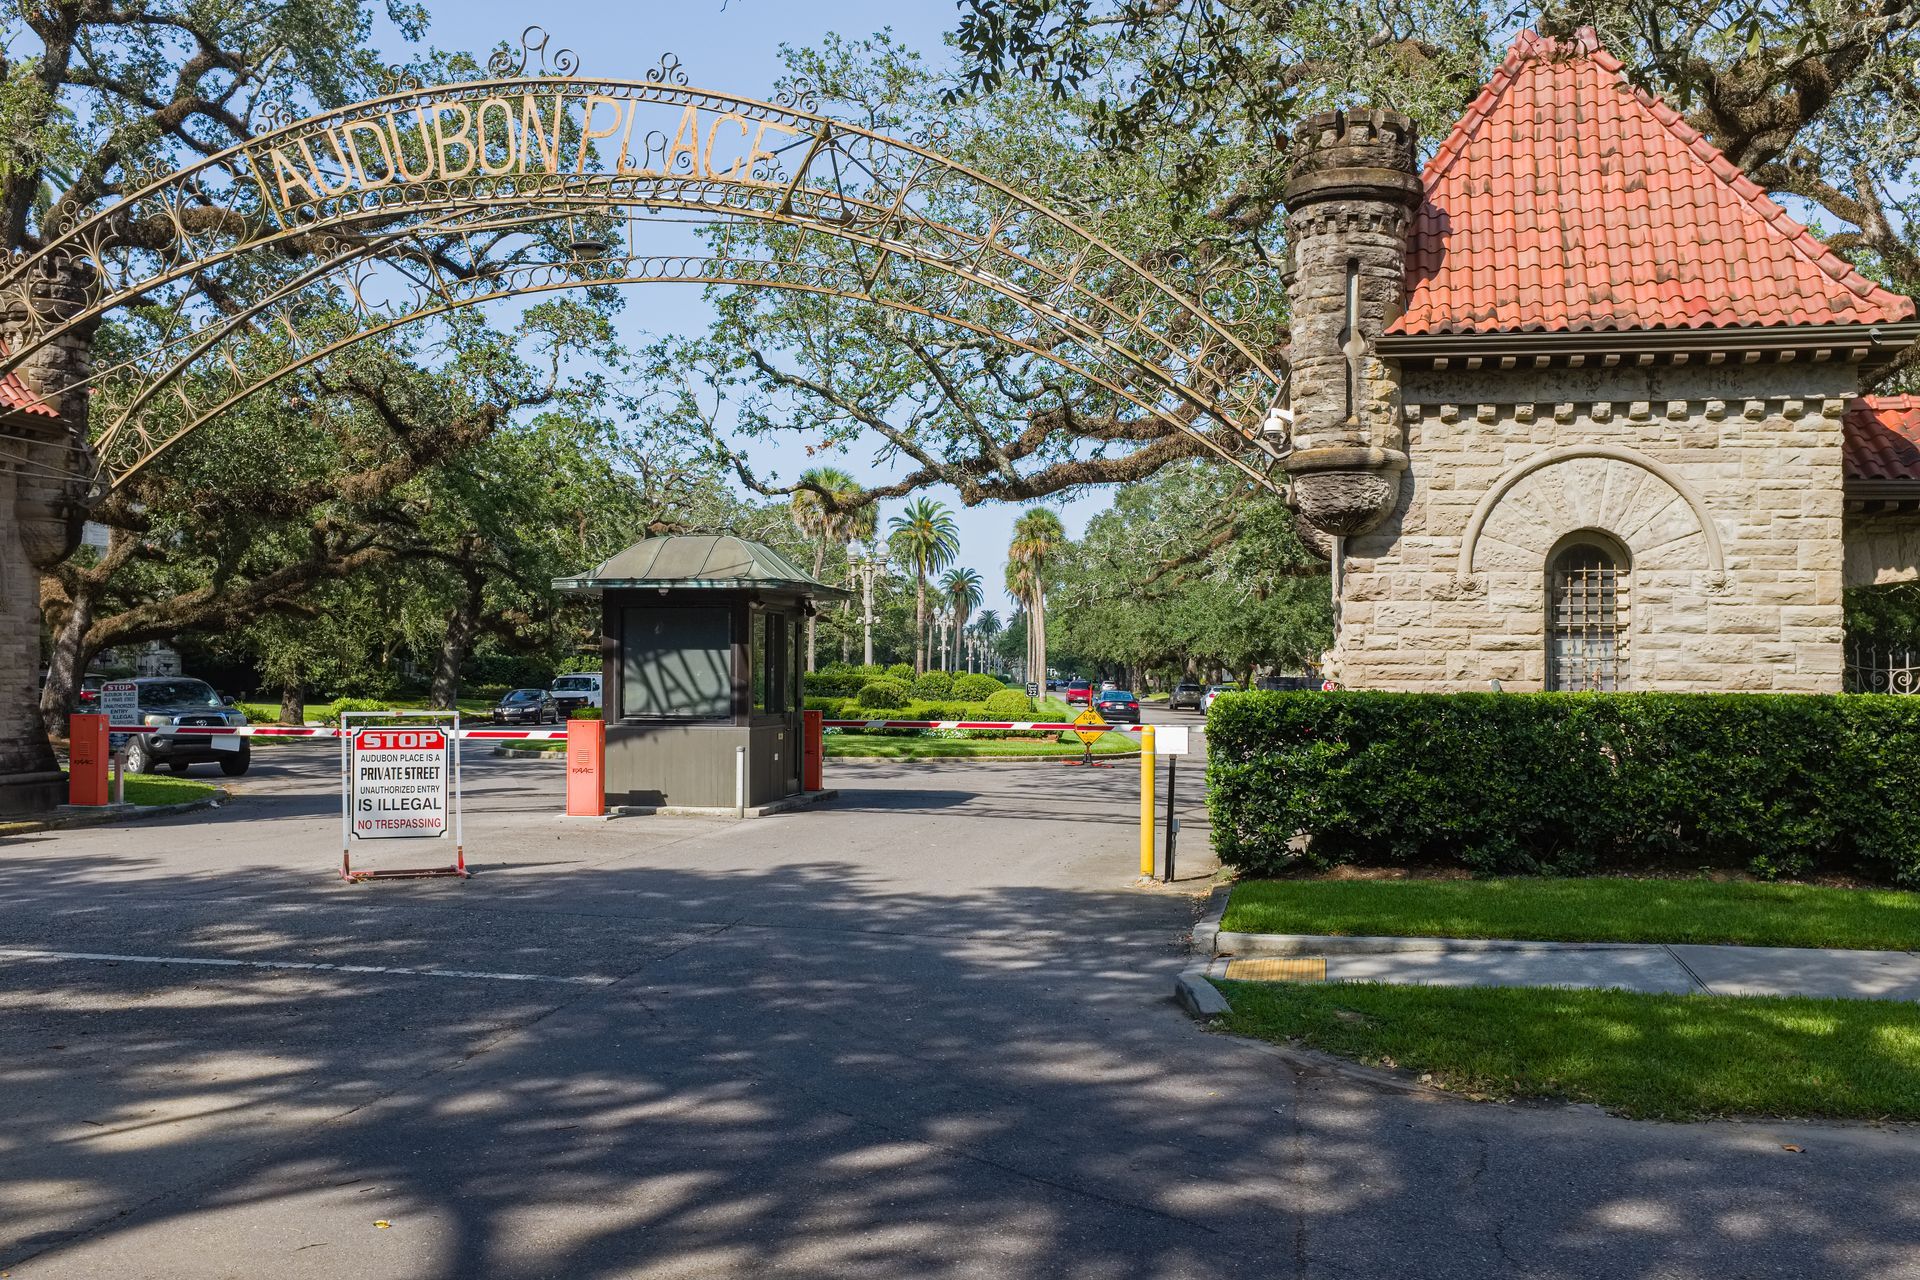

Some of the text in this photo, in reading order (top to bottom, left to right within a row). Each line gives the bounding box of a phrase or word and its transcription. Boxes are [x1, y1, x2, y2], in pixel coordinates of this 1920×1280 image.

[270, 94, 799, 208] AUDUBON PLACE
[363, 733, 438, 748] STOP
[360, 754, 398, 762] AUDUBON
[400, 753, 424, 762] PLACE
[426, 753, 434, 762] IS
[360, 766, 440, 780] PRIVATE STREET
[360, 785, 440, 795] UNAUTHORIZED ENTRY
[358, 797, 442, 812] IS ILLEGAL
[358, 818, 442, 830] NO TRESPASSING
